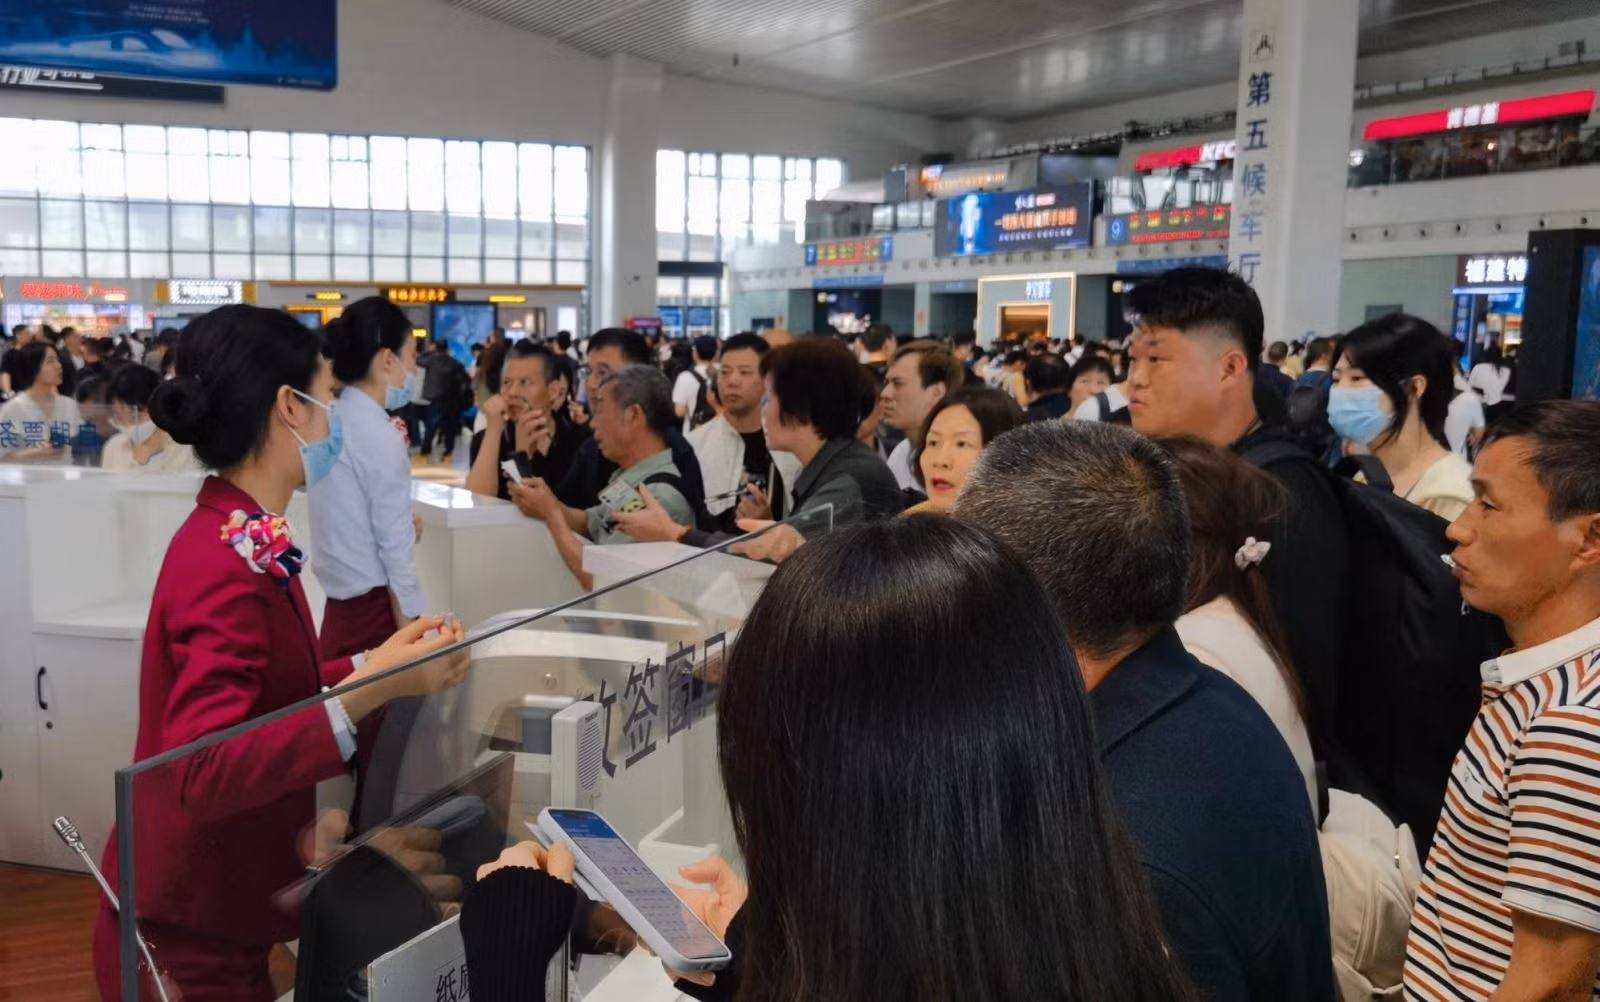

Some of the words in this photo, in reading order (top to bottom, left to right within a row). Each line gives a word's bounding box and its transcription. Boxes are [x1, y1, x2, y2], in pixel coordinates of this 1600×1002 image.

[1200, 140, 1236, 162] KFC
[1236, 72, 1273, 284] 第五候车厅
